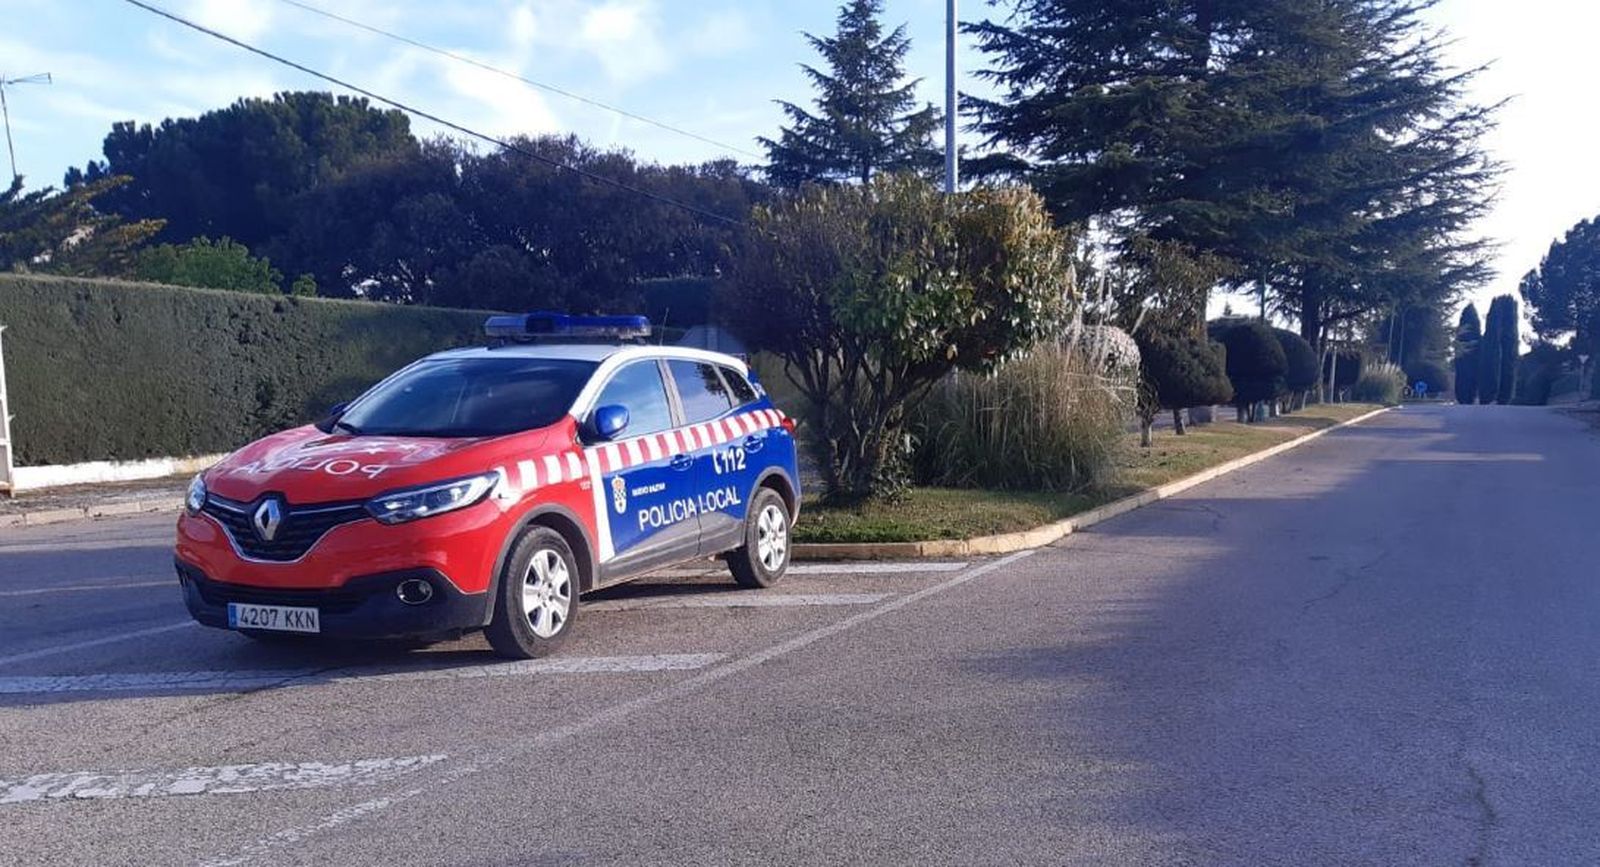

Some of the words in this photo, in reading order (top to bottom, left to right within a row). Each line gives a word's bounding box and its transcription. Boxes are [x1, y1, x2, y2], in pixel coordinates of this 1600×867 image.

[722, 448, 746, 473] 112
[638, 496, 697, 531] POLICIA
[697, 486, 741, 514] LOCAL
[240, 607, 278, 627] 4207
